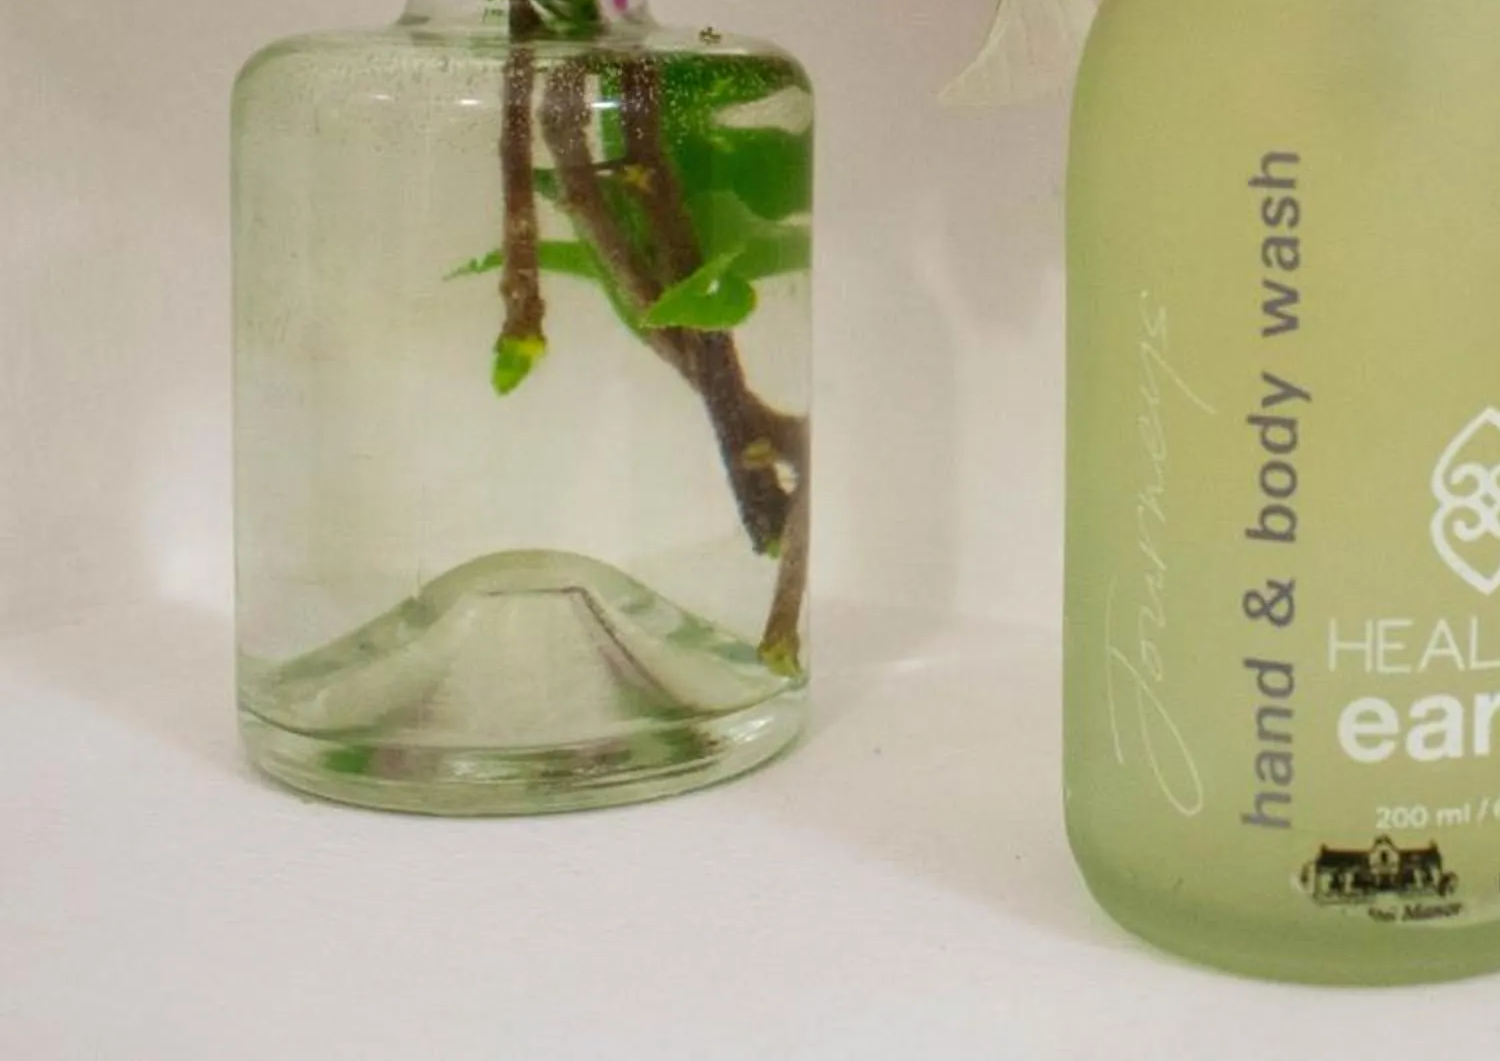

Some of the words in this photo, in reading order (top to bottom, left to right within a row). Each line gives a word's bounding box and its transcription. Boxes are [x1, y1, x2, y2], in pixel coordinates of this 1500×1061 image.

[1247, 150, 1301, 338] wash
[1245, 371, 1312, 543] body
[1242, 578, 1294, 627] &
[1241, 658, 1294, 830] hand
[1376, 805, 1429, 831] 200
[1436, 802, 1472, 827] ml
